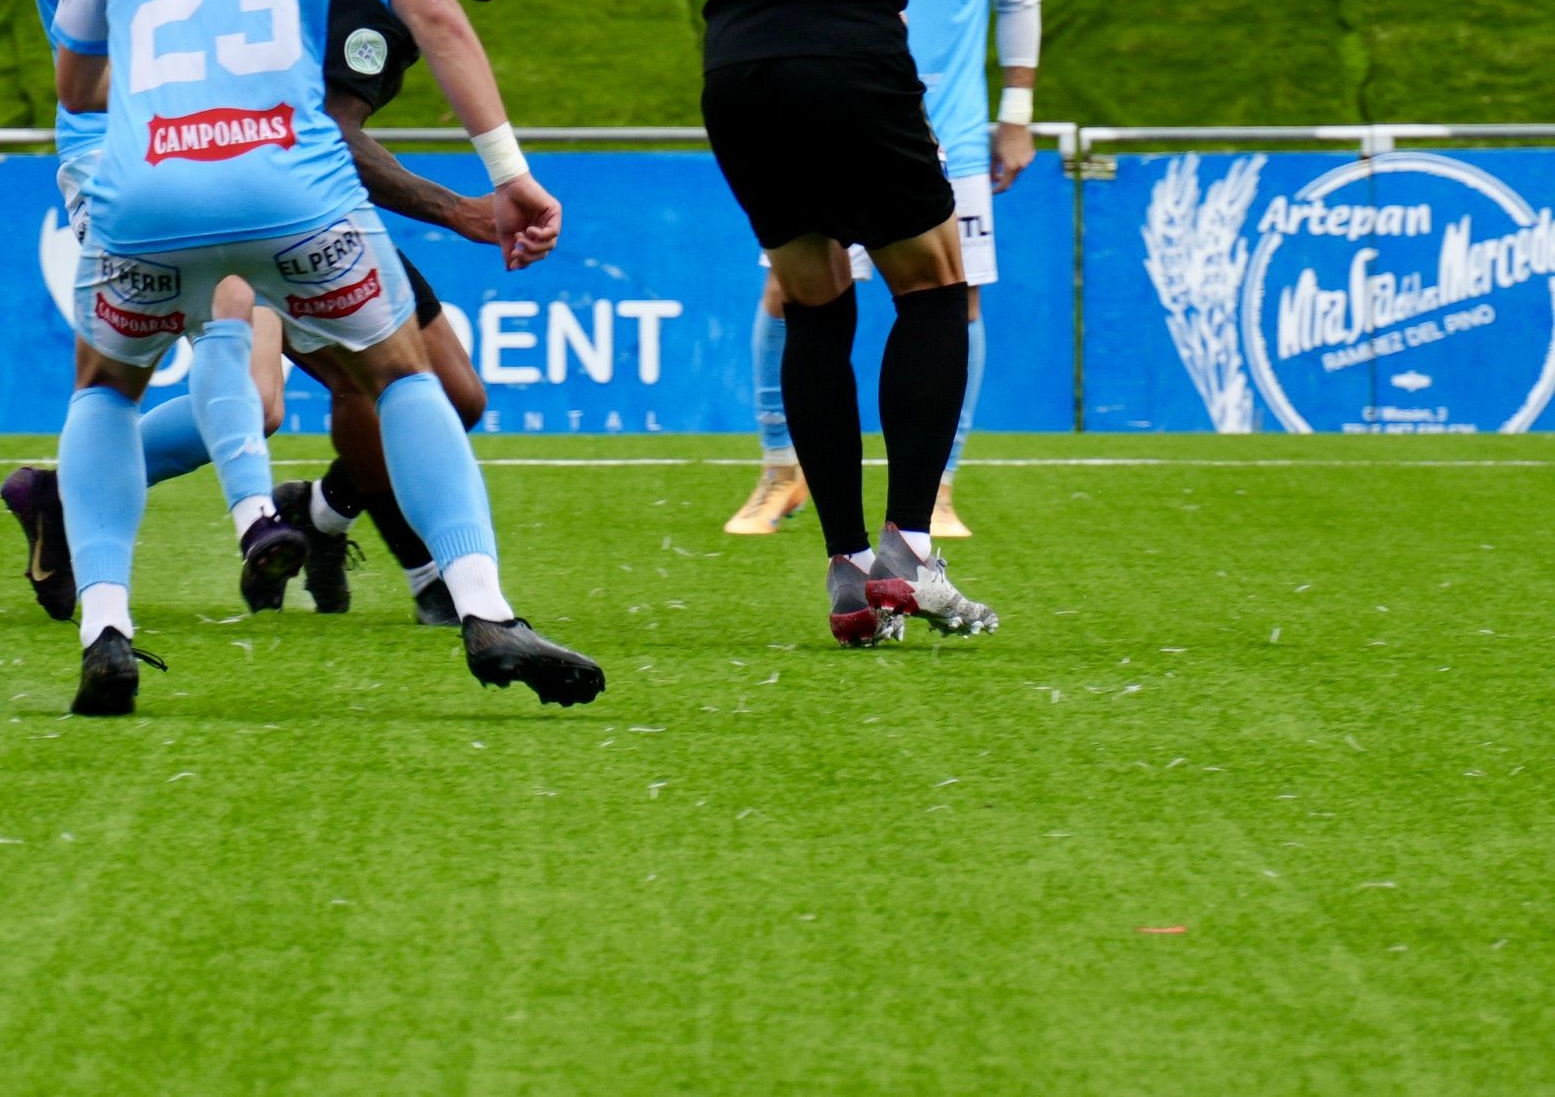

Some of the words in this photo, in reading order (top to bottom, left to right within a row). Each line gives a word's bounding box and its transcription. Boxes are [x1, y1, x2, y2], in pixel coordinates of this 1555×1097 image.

[153, 116, 288, 155] CAMPOARAS
[1259, 195, 1432, 241] Artepan
[278, 259, 308, 276] EL
[1438, 207, 1555, 305] Merced
[1404, 321, 1445, 348] DEL
